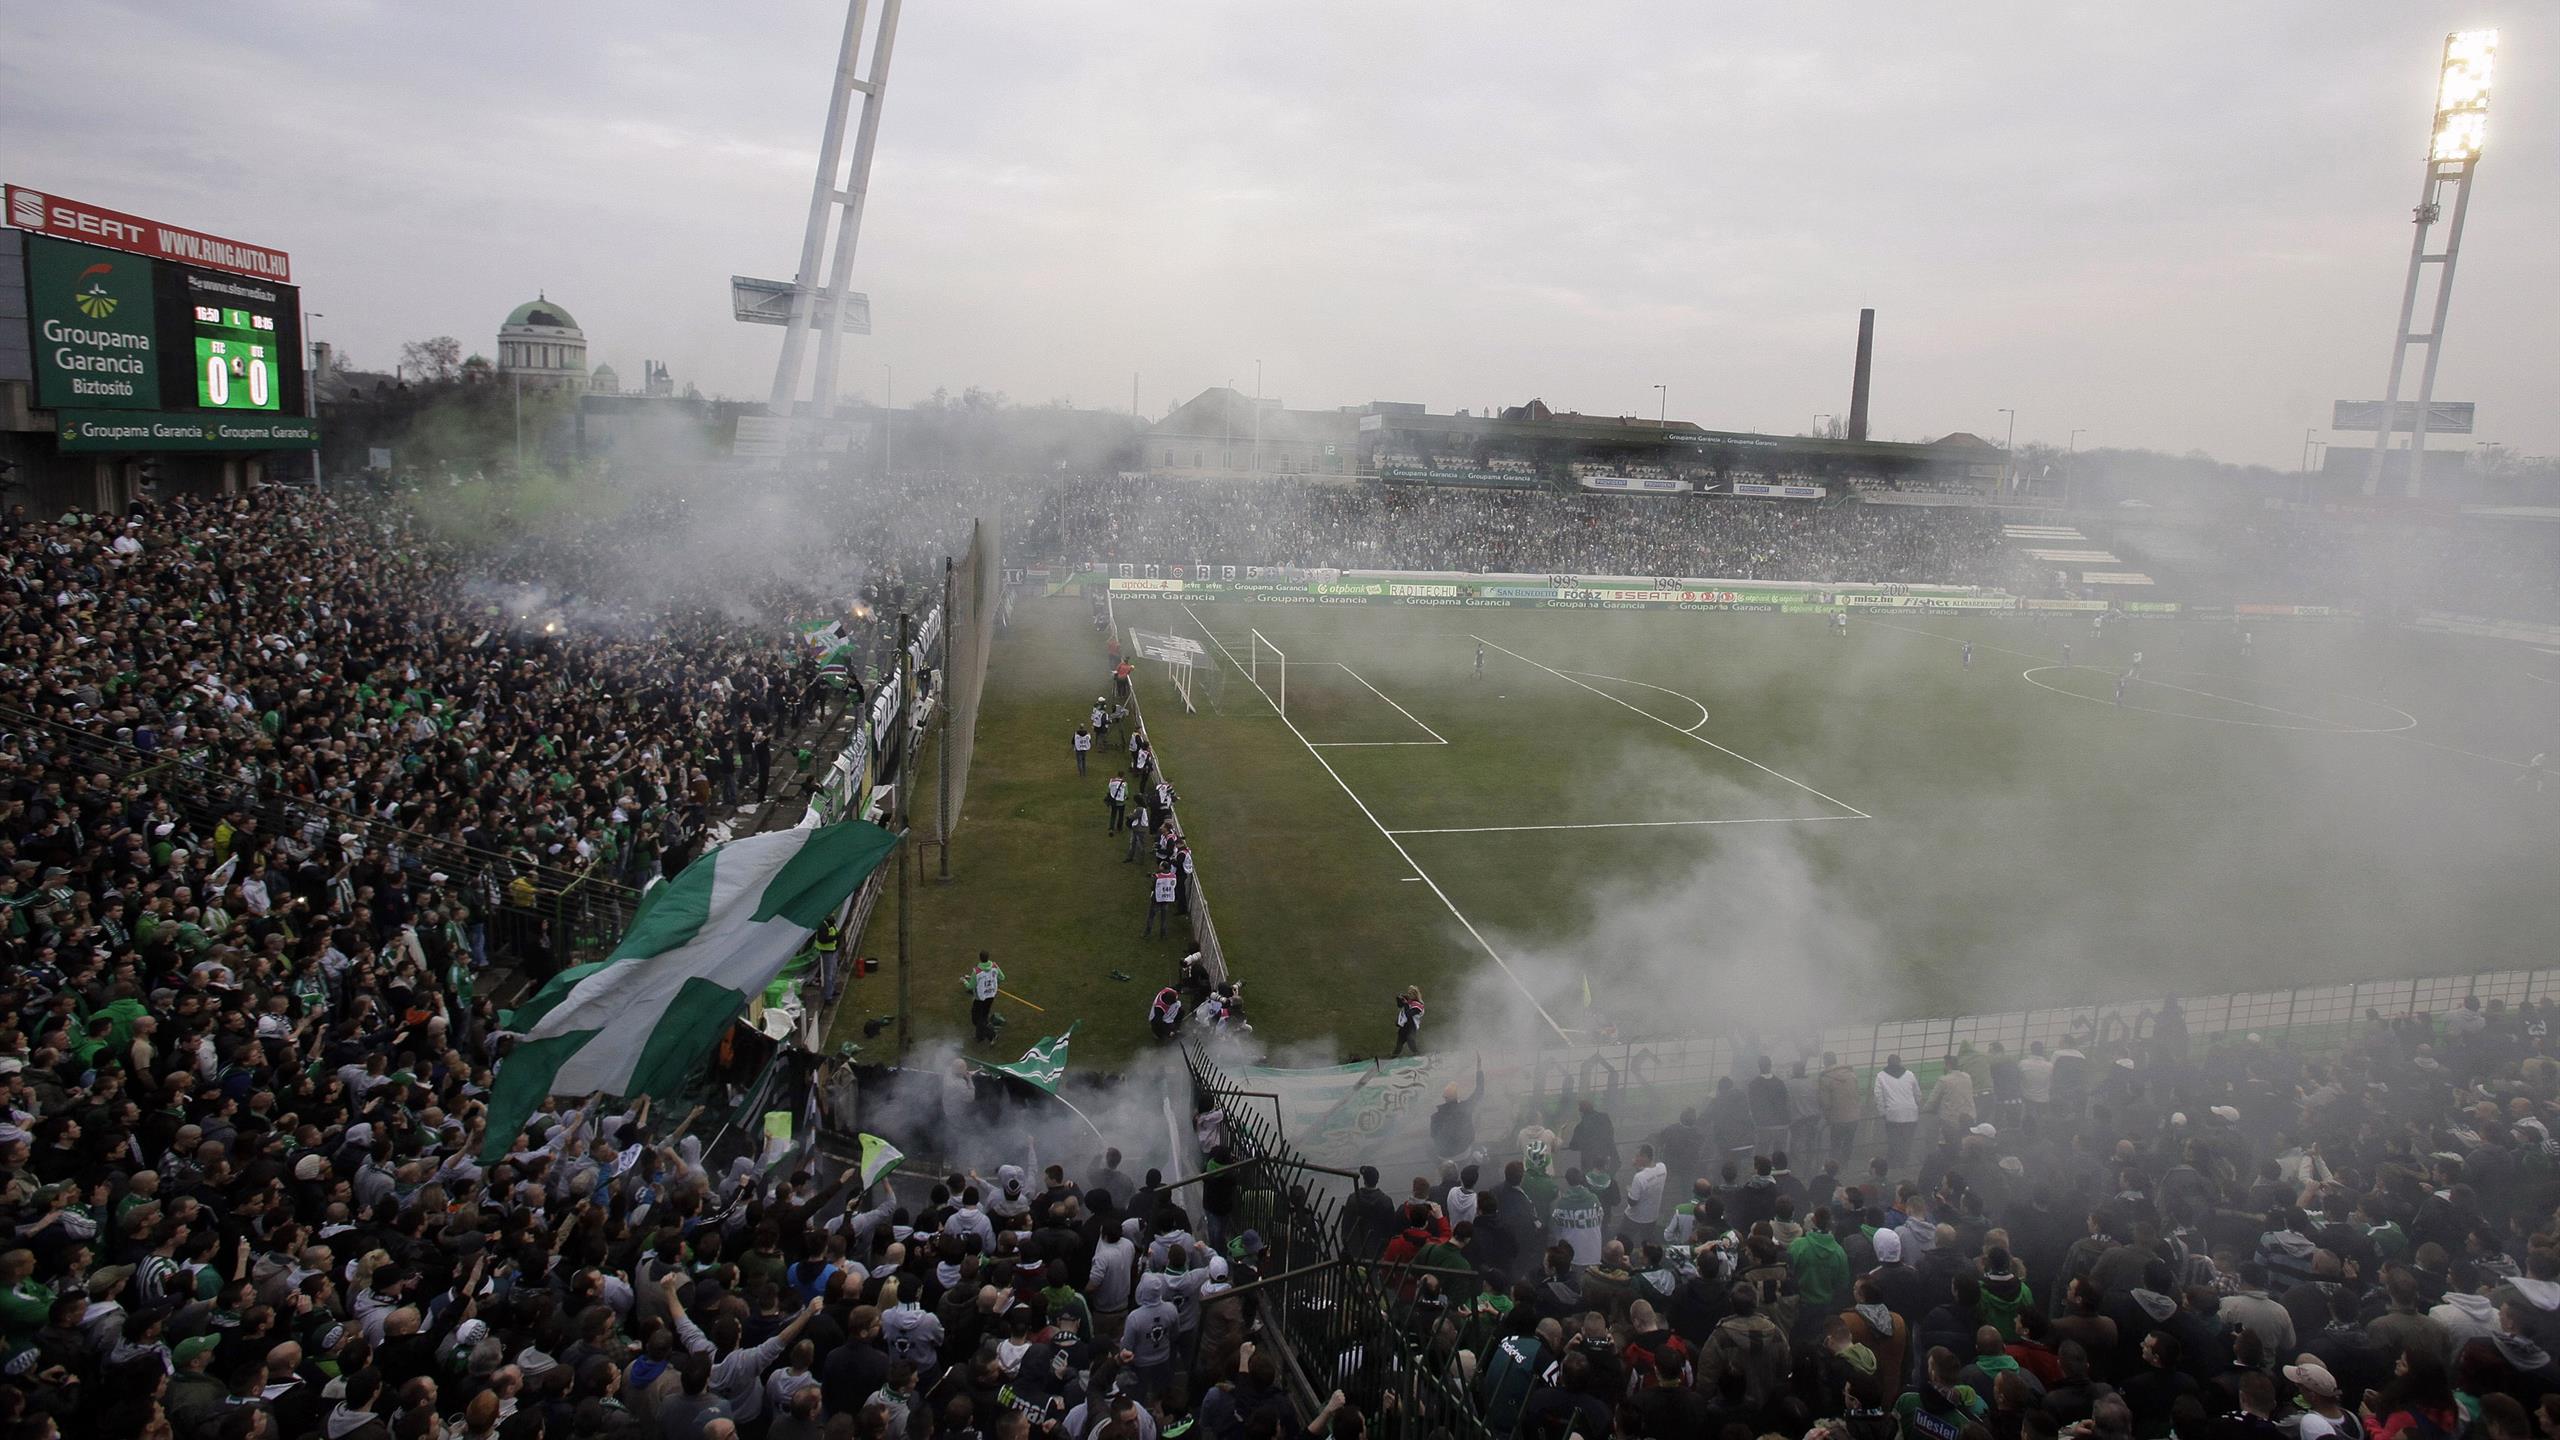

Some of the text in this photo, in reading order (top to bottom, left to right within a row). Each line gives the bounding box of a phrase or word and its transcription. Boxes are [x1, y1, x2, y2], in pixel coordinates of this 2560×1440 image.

[52, 208, 145, 243] SEAT
[157, 228, 287, 277] WWW.RINGAUTO.HU
[43, 319, 149, 350] Groupama
[55, 347, 144, 374] Garancia
[208, 356, 229, 405] 0
[250, 359, 269, 406] 0
[82, 422, 203, 440] Groupama Garancia
[219, 425, 309, 440] Groupama Garancia
[1697, 435, 1720, 443] Garancia
[1755, 439, 1777, 447] Garancia
[1393, 468, 1458, 480] Groupama Garancia
[1468, 471, 1531, 483] Groupama Garancia
[1234, 583, 1273, 593] Groupama
[1275, 584, 1308, 592] Garancia
[1549, 575, 1579, 589] 1995
[1654, 577, 1683, 591] 1996
[1329, 584, 1365, 594] otpbank
[1162, 592, 1216, 602] Garancia
[1257, 594, 1367, 605] Groupama Garancia
[1406, 597, 1511, 607] Groupama Garancia
[1624, 592, 1671, 600] SEAT
[1602, 601, 1645, 609] Garancia
[1732, 604, 1772, 612] Garancia
[1501, 1341, 1527, 1364] adidas
